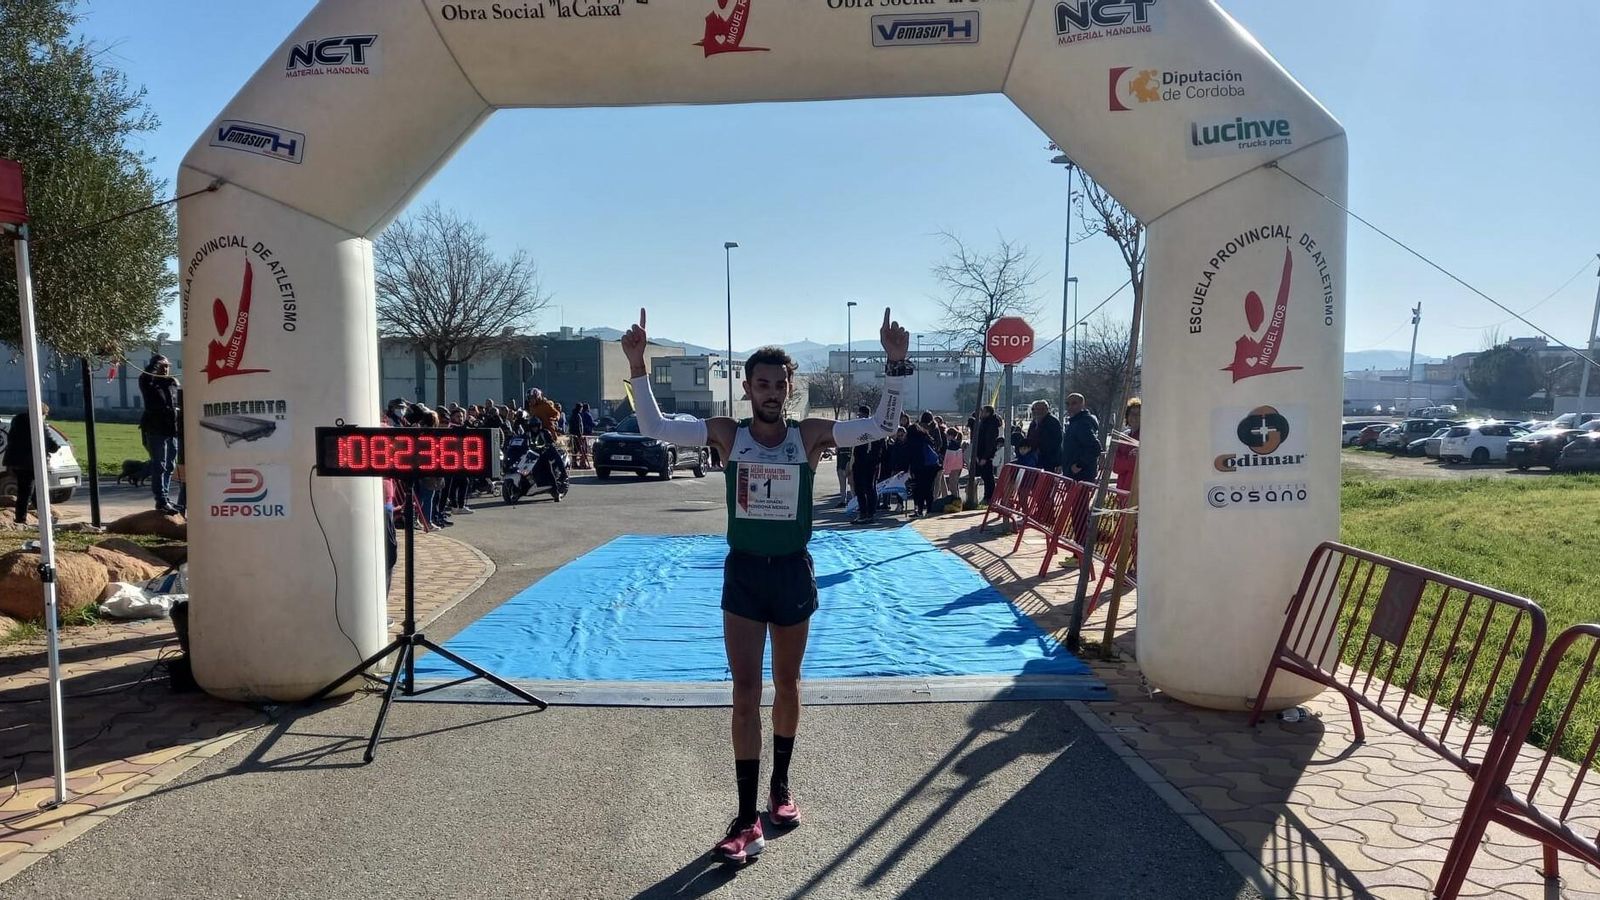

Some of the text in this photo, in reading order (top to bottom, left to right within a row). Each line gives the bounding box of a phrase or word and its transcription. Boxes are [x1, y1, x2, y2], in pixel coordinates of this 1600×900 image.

[441, 4, 487, 21] Obra
[492, 1, 545, 20] Social
[1055, 0, 1157, 35] NCT
[727, 10, 744, 45] MIGUEL
[1058, 25, 1152, 45] MATERIAL HANDLING
[285, 34, 378, 70] NCT
[286, 66, 369, 78] MATERIAL HANDLING
[1162, 69, 1243, 86] Diputación
[1162, 88, 1181, 101] de
[1238, 140, 1267, 149] trucks
[189, 234, 248, 278] PROVINCIAL
[252, 241, 273, 261] DE
[267, 260, 297, 333] ATLETISMO
[1189, 224, 1334, 334] ESCUELA PROVINCIAL DE ATLETISMO
[226, 311, 249, 368] MIGUEL RIOS
[991, 335, 1031, 347] STOP
[1259, 303, 1287, 367] MIGUEL RIOS
[763, 478, 772, 499] 1
[210, 504, 285, 517] DEPOSUR
